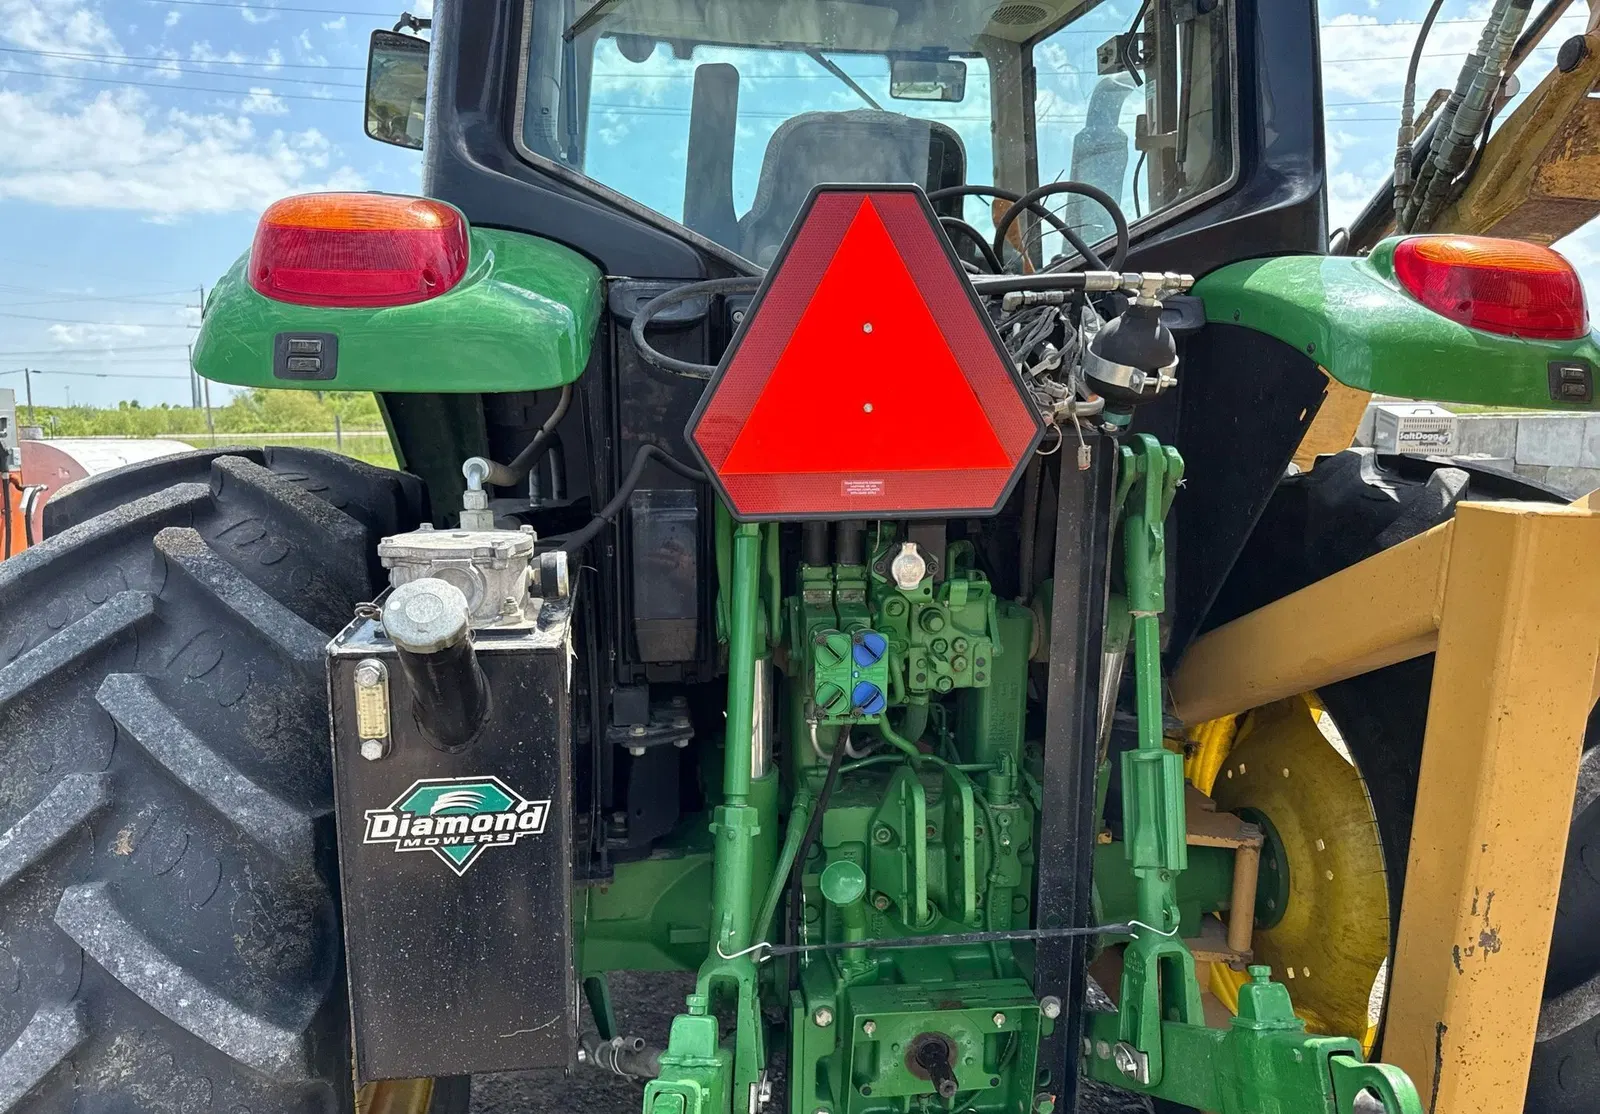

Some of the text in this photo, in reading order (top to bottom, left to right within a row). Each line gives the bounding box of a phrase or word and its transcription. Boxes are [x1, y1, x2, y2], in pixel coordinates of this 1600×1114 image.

[1400, 432, 1439, 441] SaltDogg
[371, 806, 542, 838] Diamond
[403, 833, 511, 847] MOWERS
